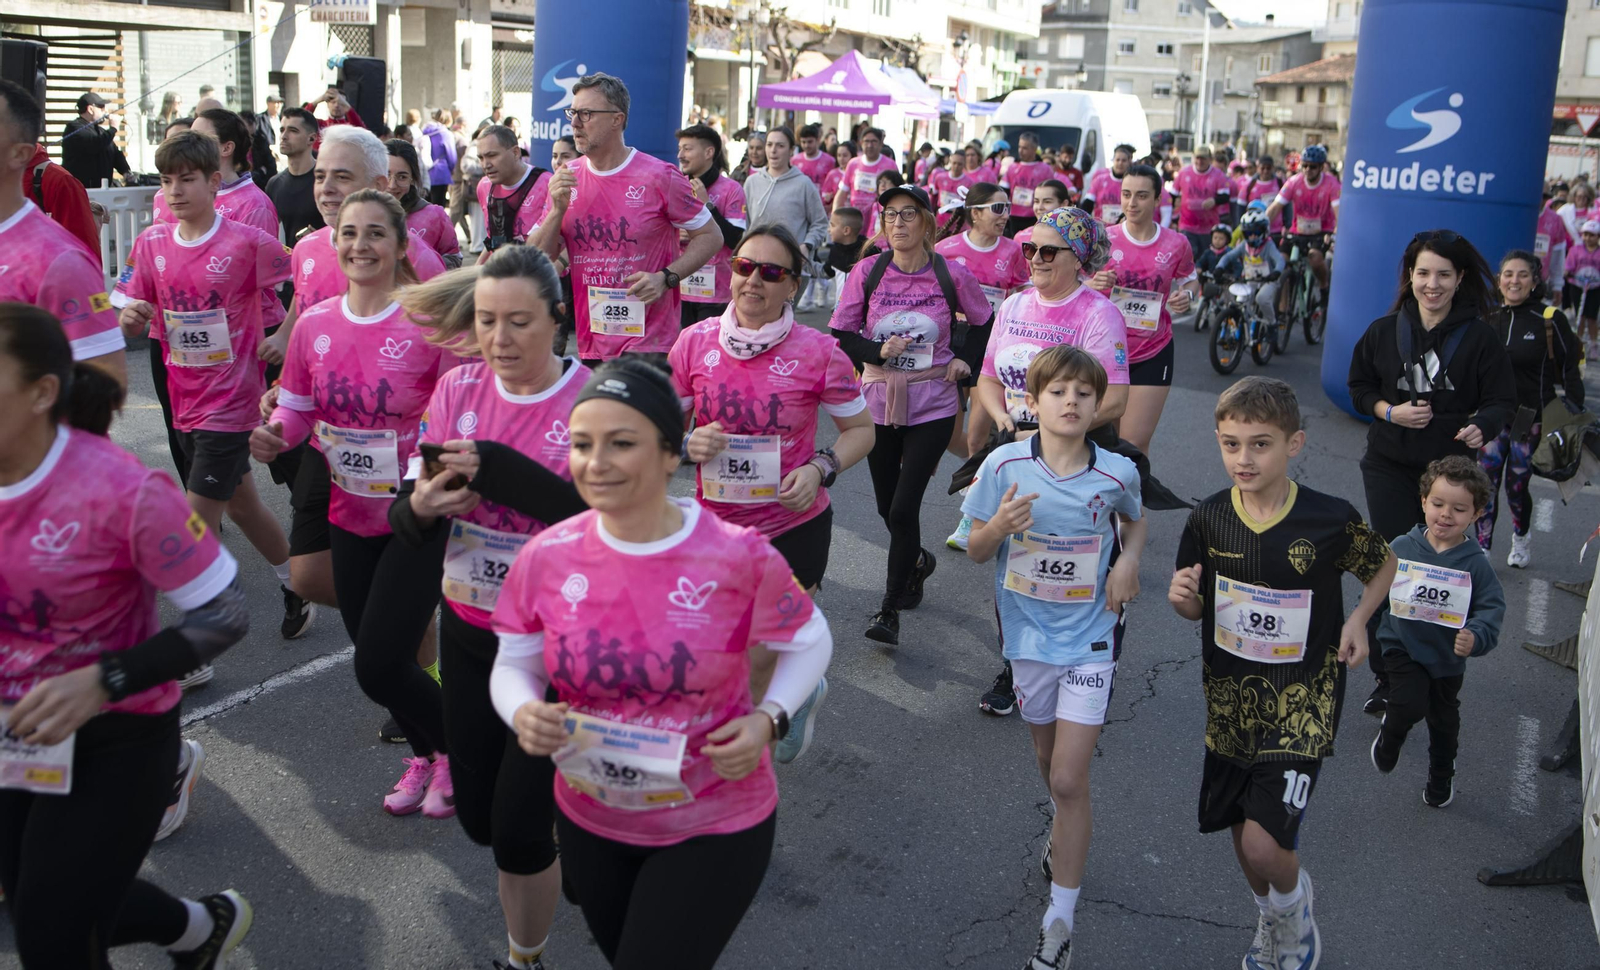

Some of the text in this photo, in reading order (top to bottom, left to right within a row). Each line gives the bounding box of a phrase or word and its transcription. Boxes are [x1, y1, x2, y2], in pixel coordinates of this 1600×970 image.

[833, 98, 874, 109] IGUALDADE
[1352, 159, 1496, 196] Saudeter
[690, 275, 704, 283] 247
[605, 305, 629, 317] 238
[1126, 302, 1147, 313] 196
[182, 331, 209, 343] 163
[894, 356, 915, 368] 175
[342, 451, 373, 469] 220
[728, 459, 751, 474] 54
[1027, 534, 1052, 545] CARREIRA
[483, 559, 509, 580] 32
[1038, 559, 1076, 576] 162
[1398, 563, 1409, 573] III
[1411, 565, 1431, 573] CARREIRA
[1442, 570, 1467, 580] IGUALDADE
[1218, 579, 1302, 599] III CARREIRA POLA IGUALDADE
[1416, 585, 1450, 602] 209
[1251, 595, 1281, 606] BARBADÁS
[1249, 612, 1276, 631] 98
[1066, 669, 1105, 689] Siweb
[602, 757, 638, 780] 36
[1282, 769, 1311, 809] 10
